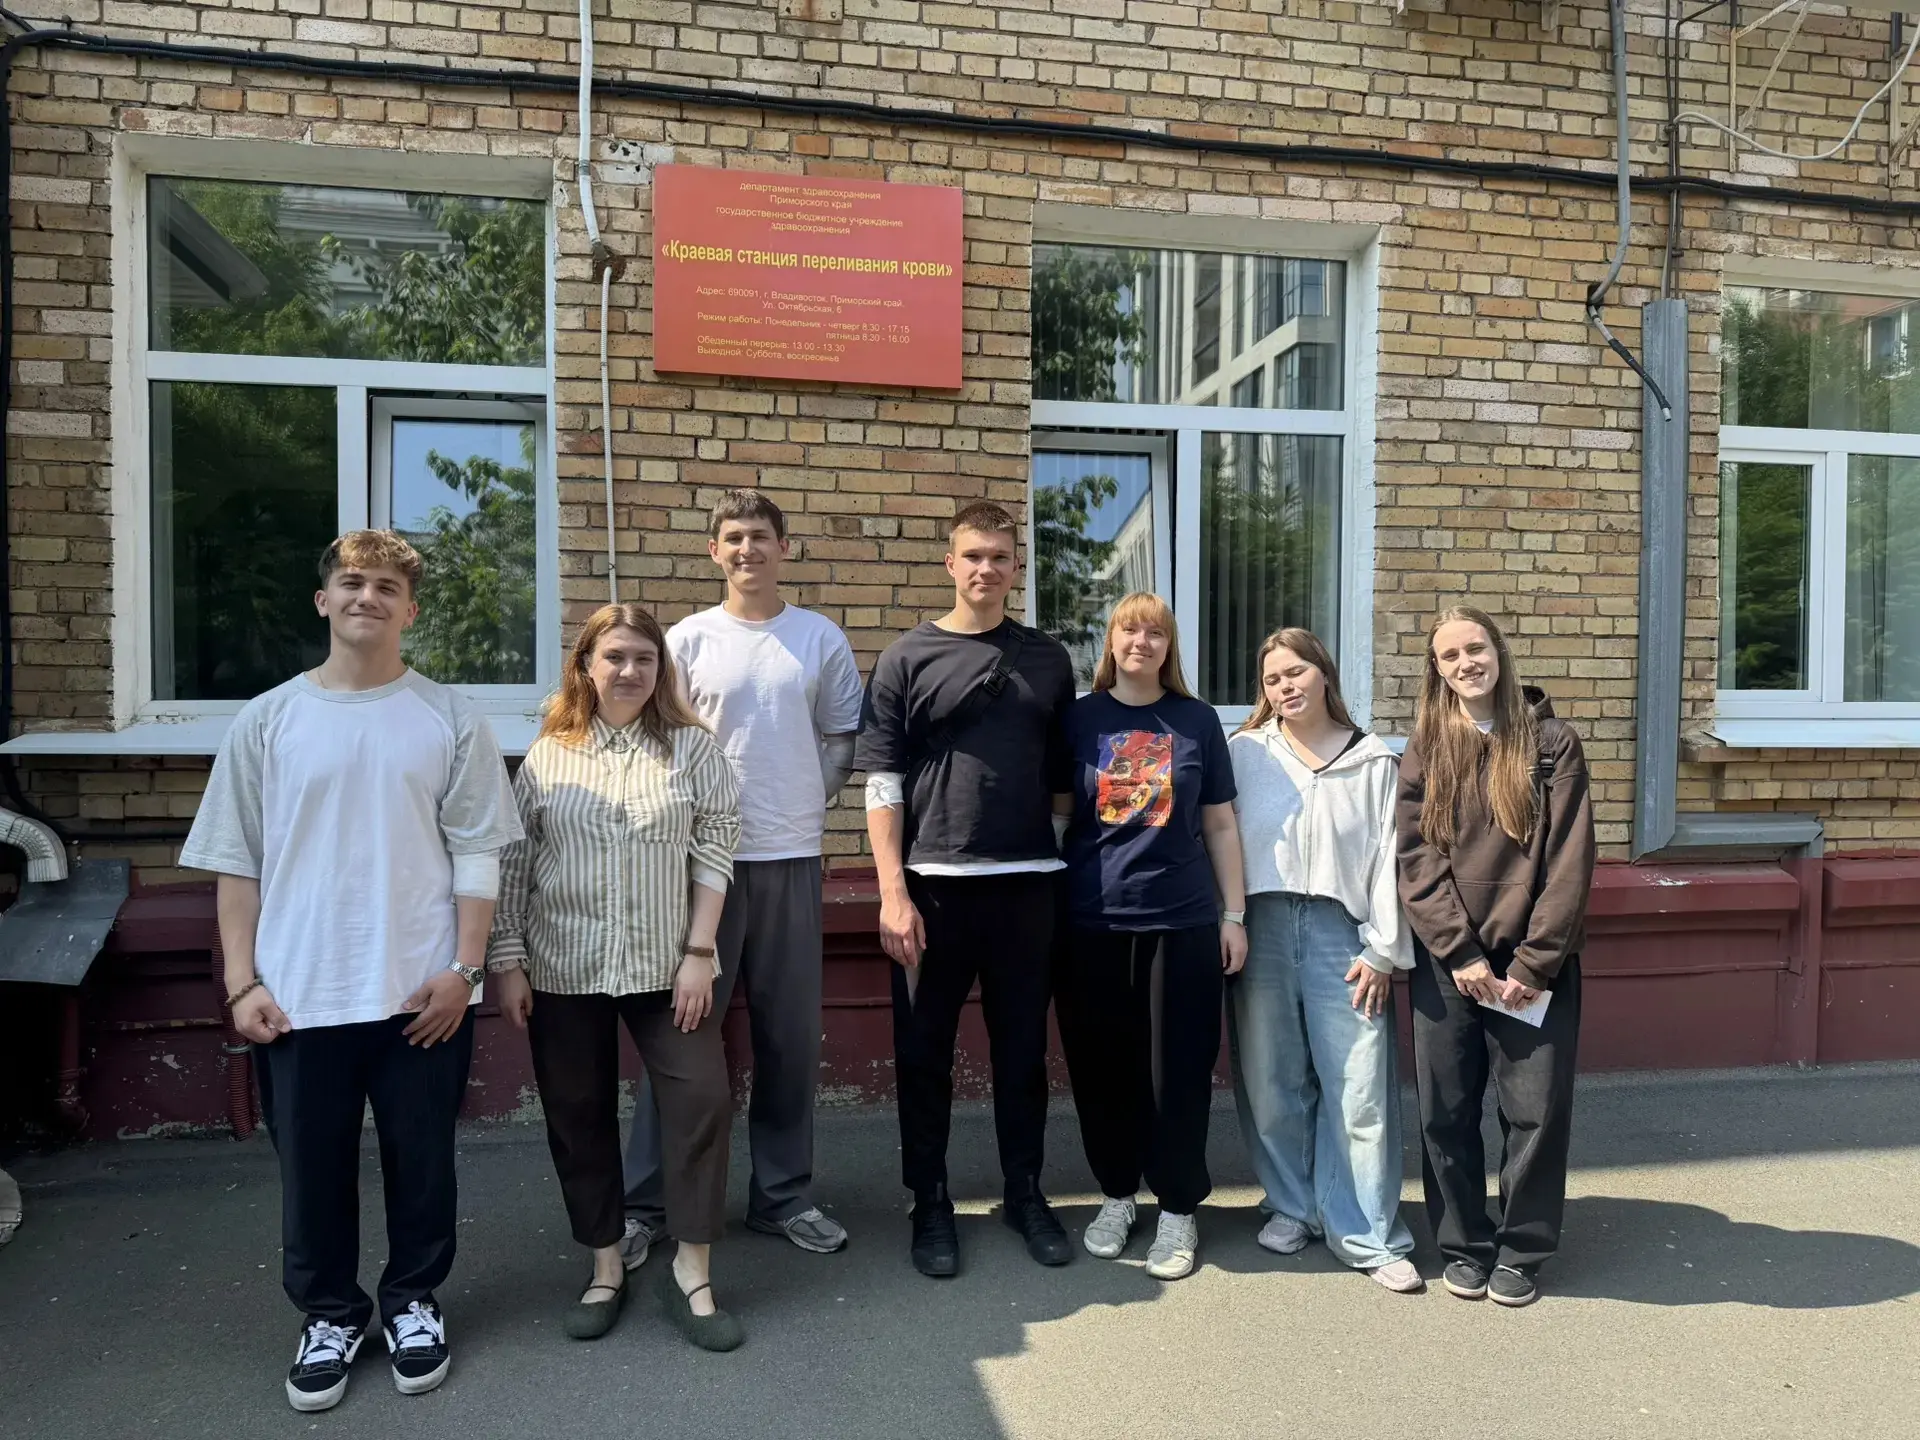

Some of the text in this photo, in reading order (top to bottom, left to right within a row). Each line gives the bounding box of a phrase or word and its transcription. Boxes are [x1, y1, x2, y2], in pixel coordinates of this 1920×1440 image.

[740, 182, 881, 200] департамент здравоохранения
[770, 194, 852, 210] Приморского края
[716, 206, 903, 228] государственное бюджетное учреждение
[771, 221, 850, 235] здравоохранения
[661, 239, 953, 279] «Краевая станция переливания крови»
[696, 285, 726, 296] Адрес:
[728, 287, 762, 299] 690091,
[830, 294, 881, 306] Приморский
[836, 305, 842, 314] 6
[697, 311, 726, 322] Режим
[728, 314, 763, 325] работы:
[765, 316, 821, 328] Понедельник
[828, 322, 861, 332] четверг
[862, 322, 880, 332] 8.30
[888, 324, 910, 334] 17.15
[697, 335, 748, 347] Обеденный
[825, 331, 861, 342] пятница
[888, 334, 910, 344] 16.00
[786, 352, 840, 363] воскресенье
